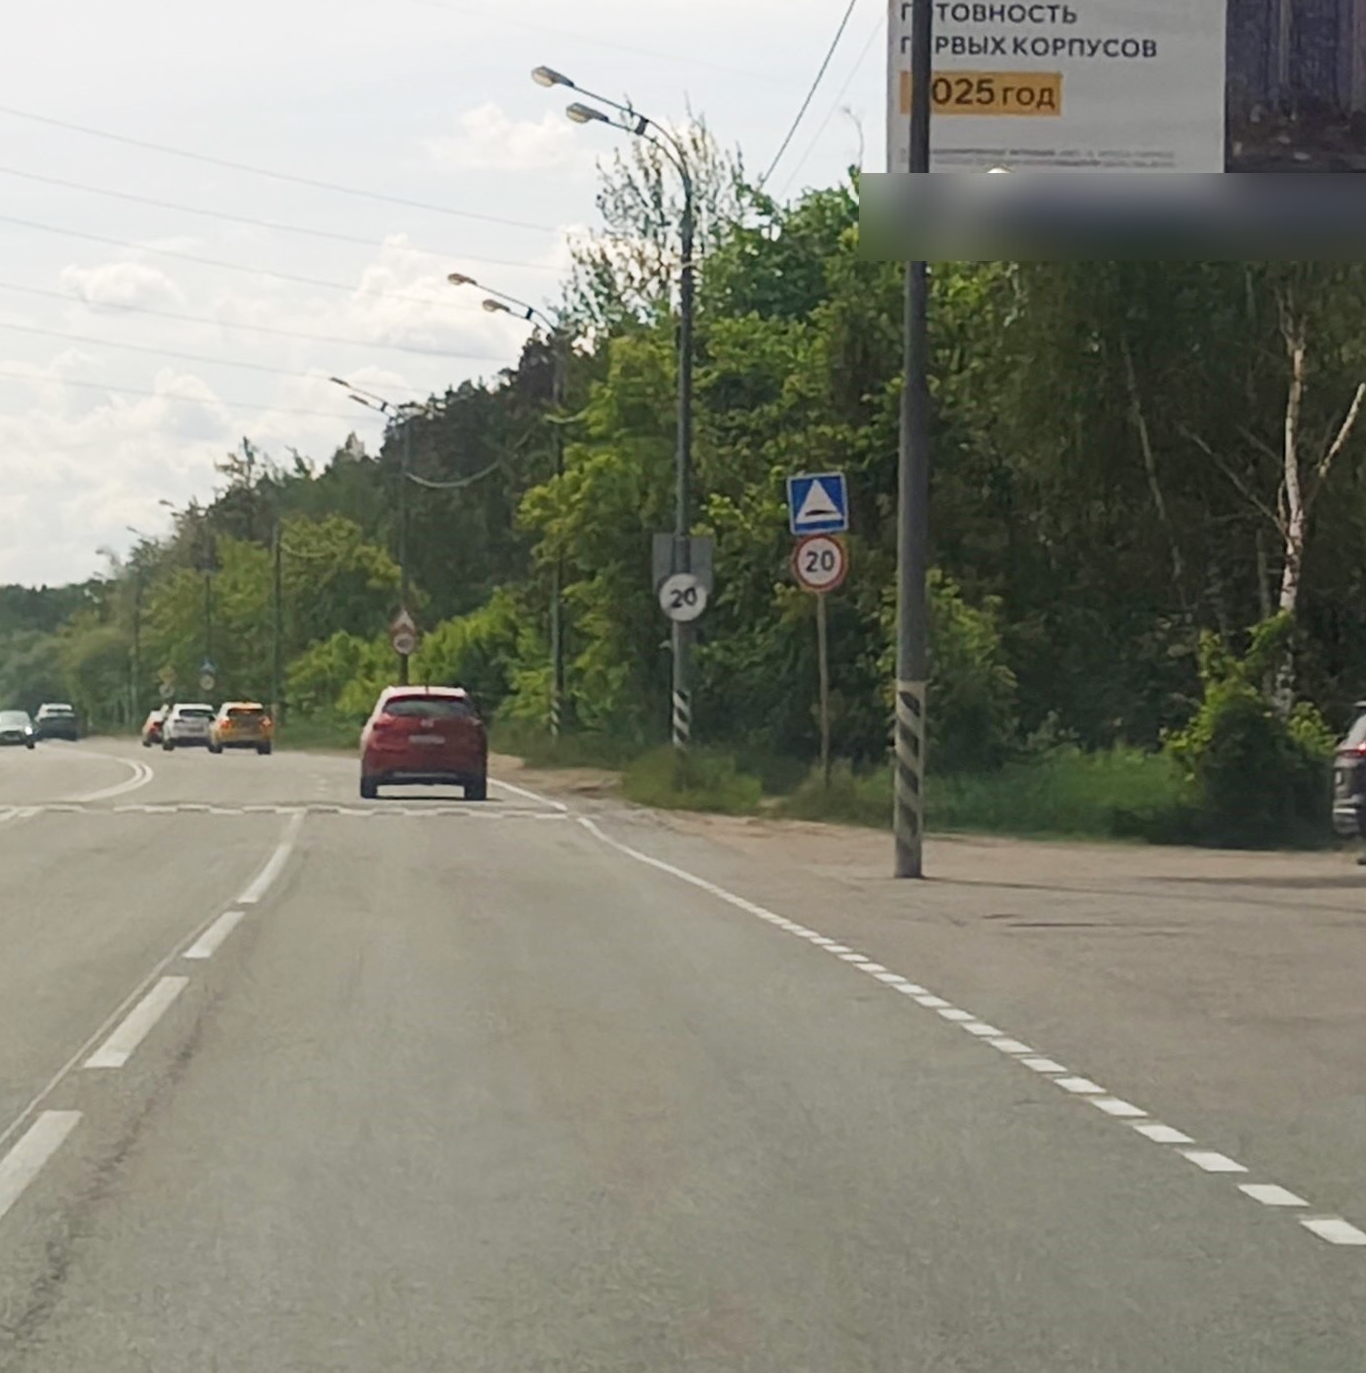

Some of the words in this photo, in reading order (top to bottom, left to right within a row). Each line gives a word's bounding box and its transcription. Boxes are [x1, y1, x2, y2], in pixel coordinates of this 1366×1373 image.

[901, 3, 1077, 24] ГТОВНОСТЬ
[1013, 37, 1158, 58] КОРПУСОВ
[930, 77, 996, 106] 025
[1002, 86, 1056, 109] год
[805, 550, 836, 573] 20
[669, 586, 698, 609] 20
